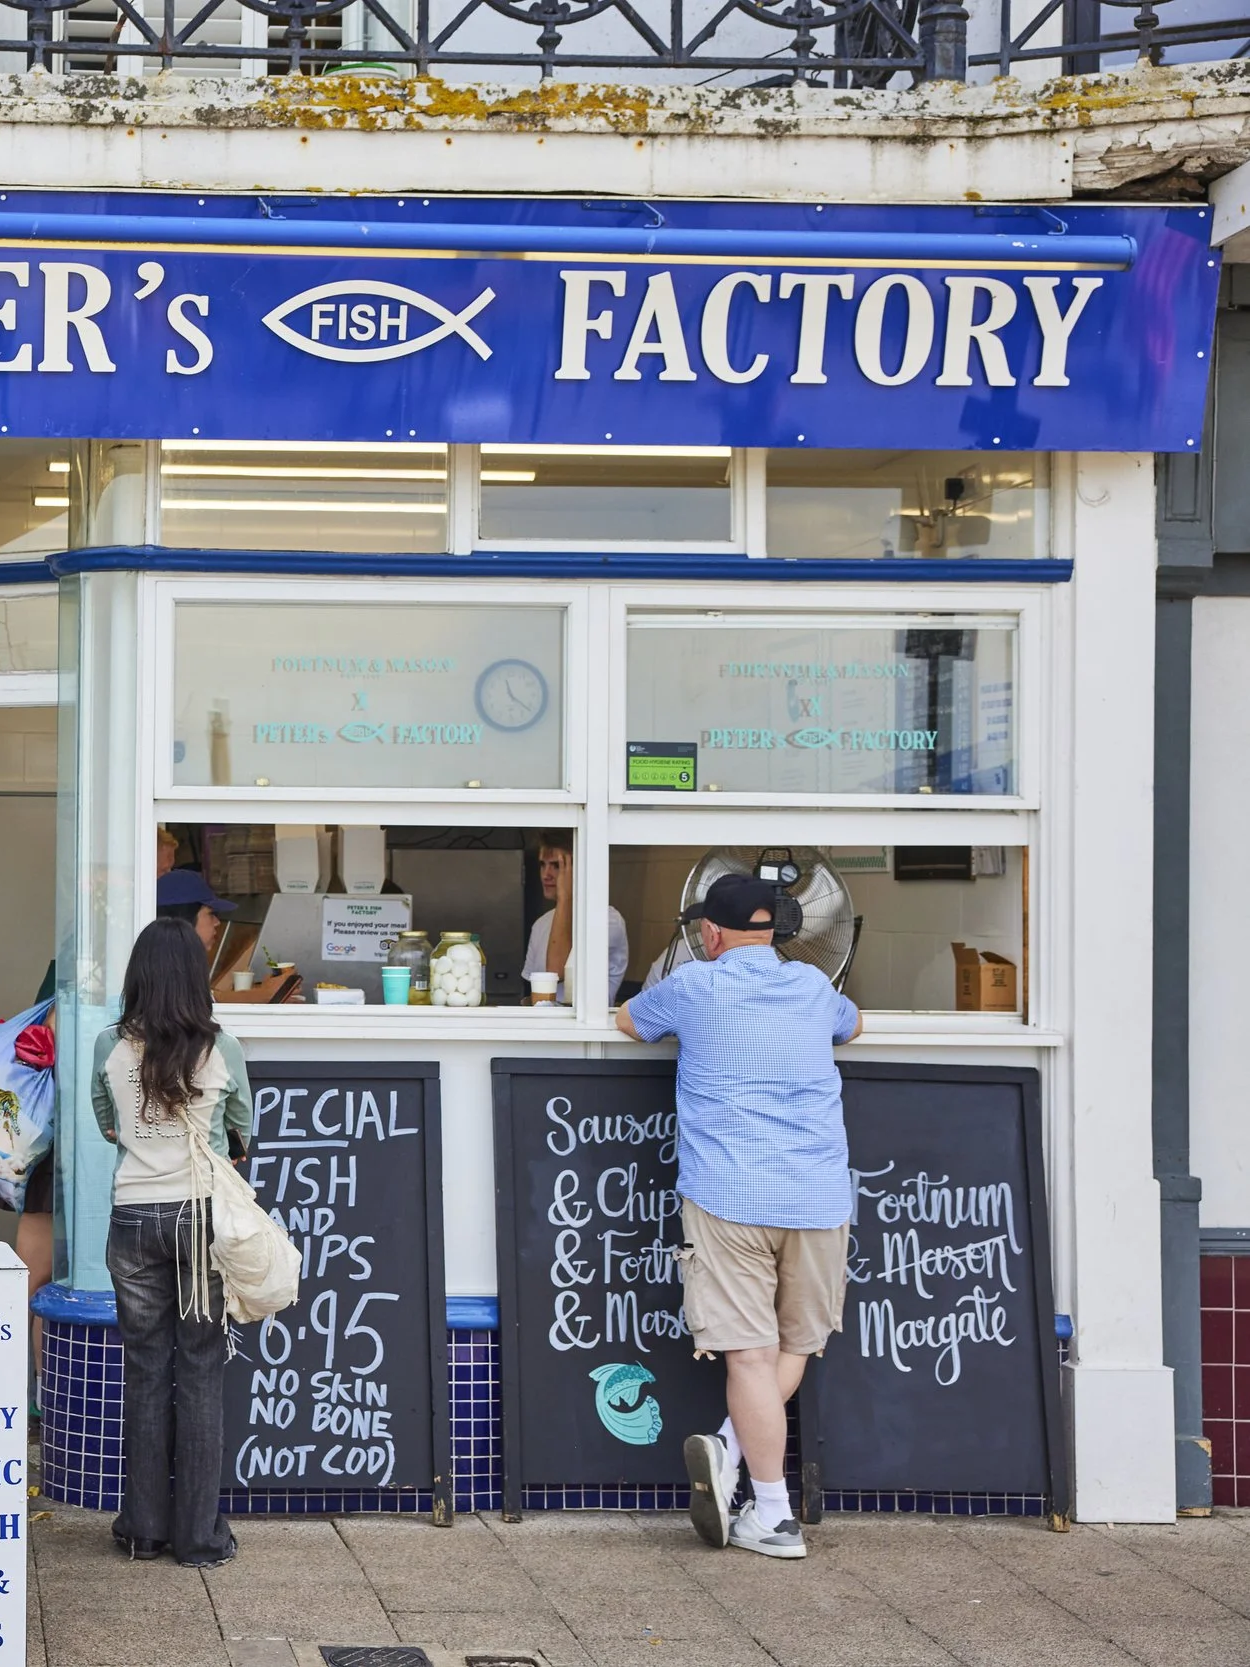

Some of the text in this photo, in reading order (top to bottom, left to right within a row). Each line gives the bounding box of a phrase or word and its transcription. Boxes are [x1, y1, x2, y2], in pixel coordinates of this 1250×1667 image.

[311, 302, 409, 342] FISH
[554, 269, 1104, 387] FACTORY
[393, 722, 484, 744] FACTORY
[850, 729, 939, 751] FACTORY
[326, 942, 357, 954] Google
[347, 921, 373, 929] enjoyed
[374, 922, 389, 930] your
[357, 928, 379, 936] review
[251, 1086, 419, 1141] PECIAL
[546, 1096, 680, 1164] Sausag
[250, 1154, 358, 1207] FISH
[549, 1162, 684, 1240] & Chip
[848, 1159, 1023, 1255] Fortnum
[289, 1234, 376, 1282] IPS
[550, 1228, 684, 1288] & Fortn
[877, 1227, 1017, 1300] Mason
[549, 1290, 691, 1353] & Maso
[858, 1285, 1016, 1386] Margate
[251, 1368, 388, 1408] NO SKIN
[249, 1397, 394, 1441] NO BONE
[235, 1434, 396, 1488] (NOT COD)
